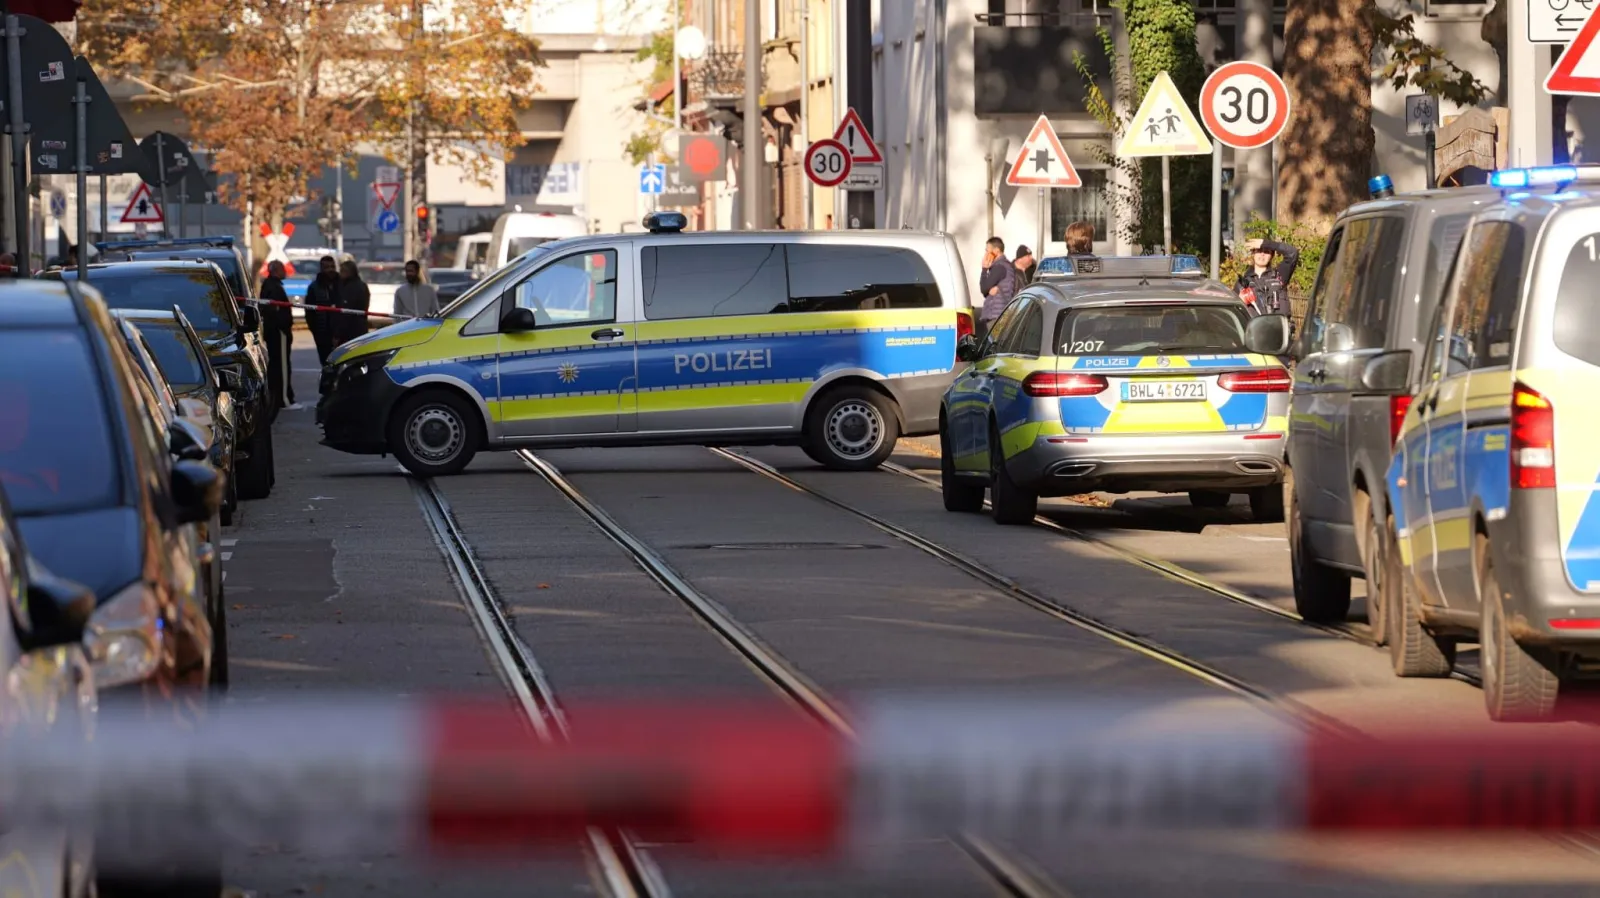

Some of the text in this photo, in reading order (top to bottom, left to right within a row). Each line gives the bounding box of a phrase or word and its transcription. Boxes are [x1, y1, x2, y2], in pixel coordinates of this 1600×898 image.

[1220, 86, 1269, 124] 30
[814, 152, 842, 174] 30
[1061, 340, 1104, 354] 1/207
[674, 348, 772, 375] POLIZEI
[1085, 358, 1129, 368] POLIZEI
[1130, 383, 1205, 398] BWL 4 6721
